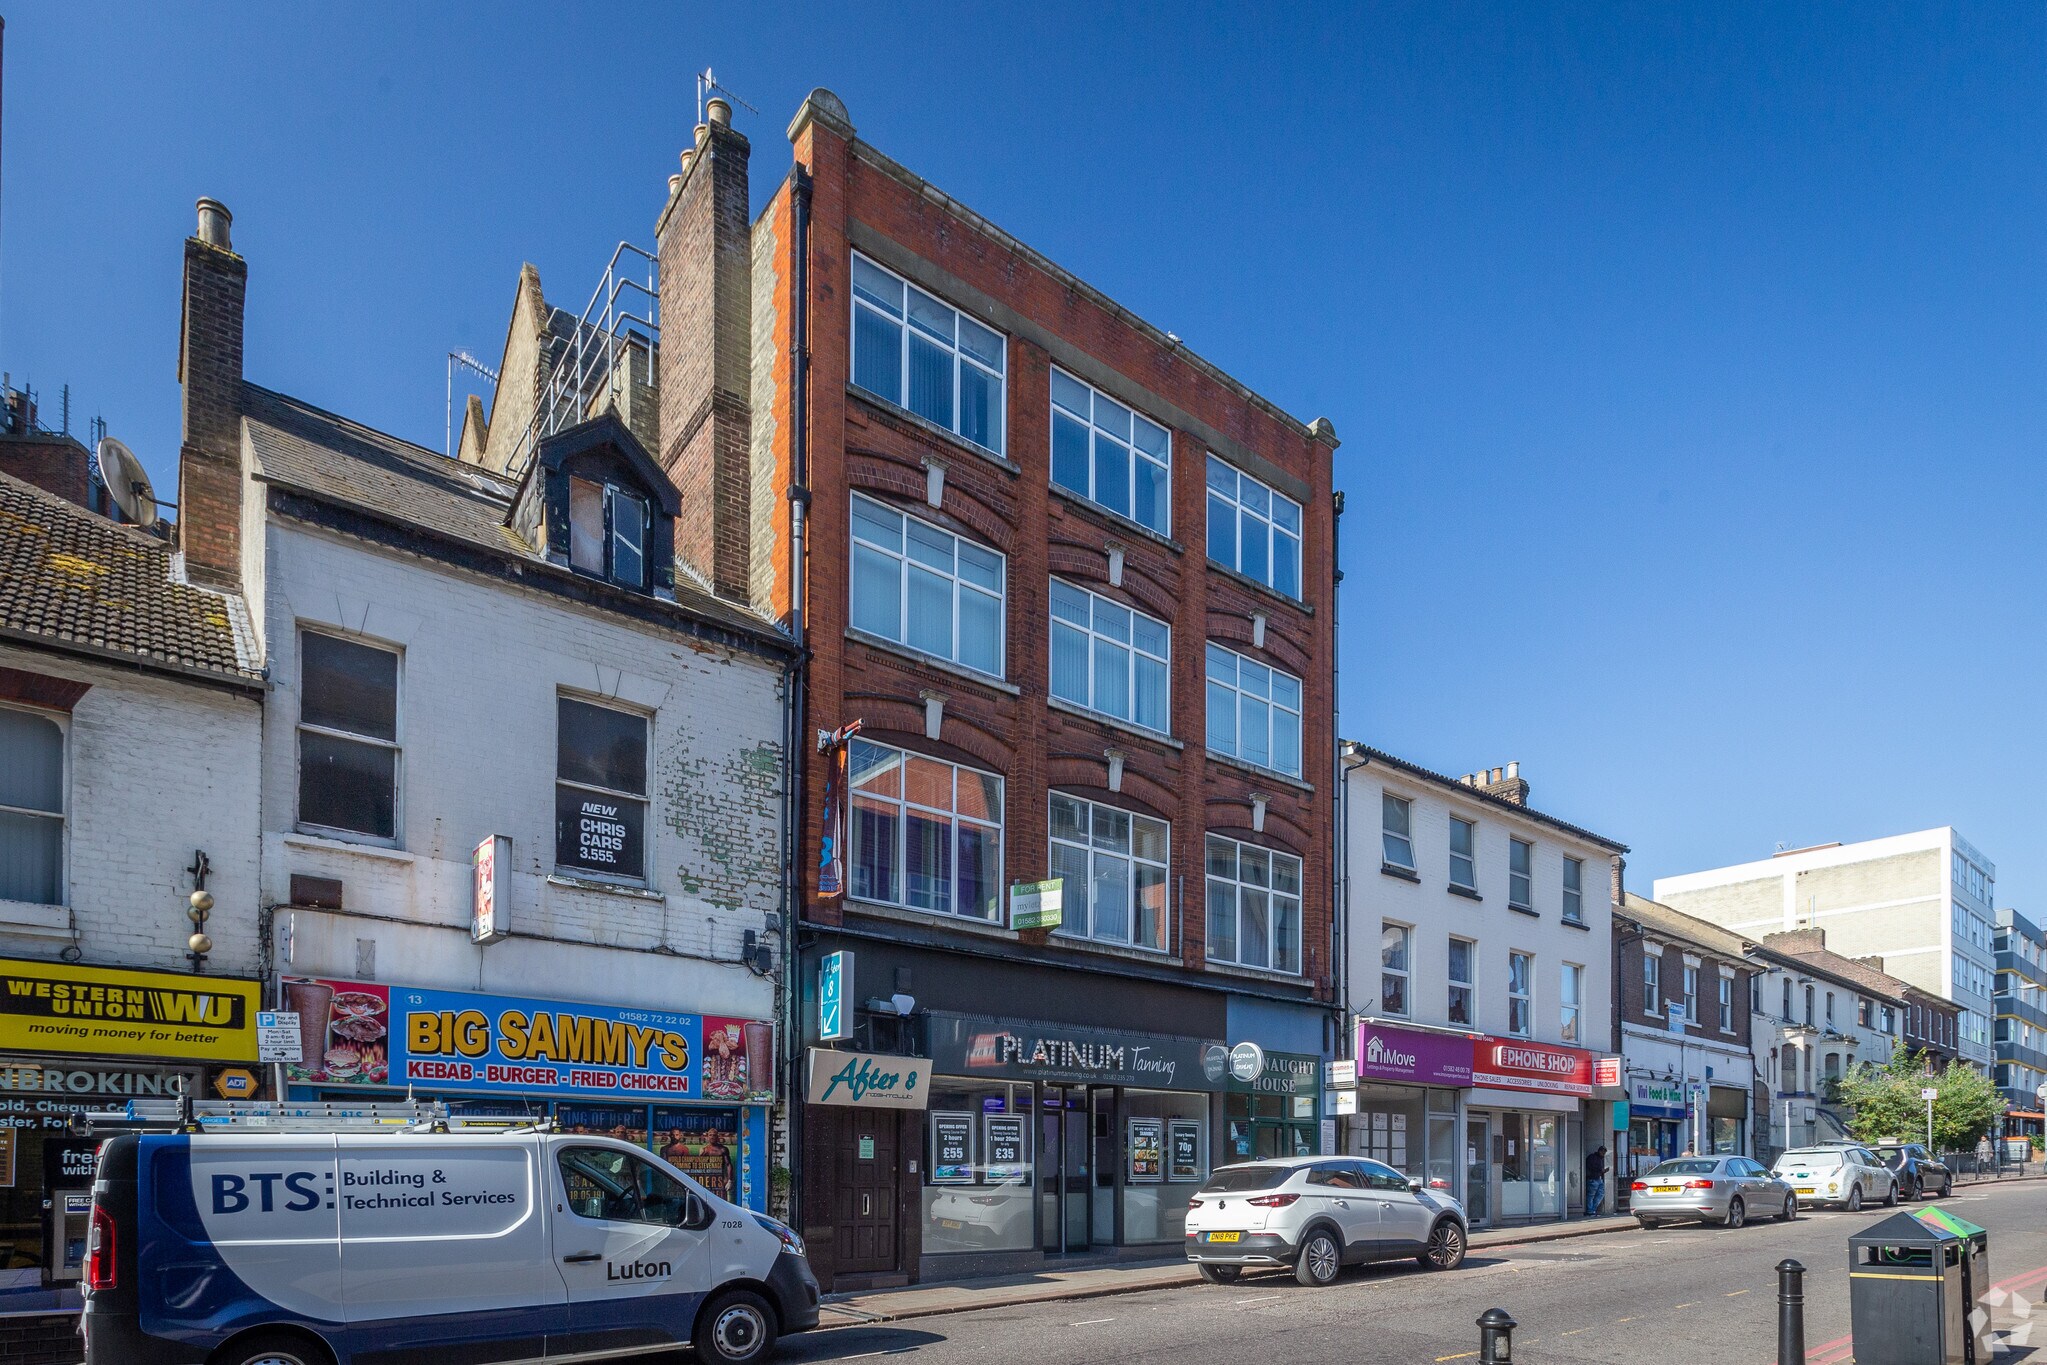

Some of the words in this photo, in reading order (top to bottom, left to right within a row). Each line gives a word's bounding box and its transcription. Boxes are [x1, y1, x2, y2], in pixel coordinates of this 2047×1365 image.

[582, 802, 617, 816] NEW
[580, 818, 626, 838] CHRIS
[580, 832, 623, 851] CARS
[580, 846, 617, 863] 3.555.
[1020, 884, 1035, 894] FOR
[1036, 882, 1056, 890] RENT
[1018, 917, 1036, 925] 01582
[826, 960, 841, 975] After
[7, 980, 145, 1004] WESTERN
[828, 980, 834, 997] 8
[408, 994, 422, 1005] 13
[52, 999, 145, 1019] UNION
[159, 992, 232, 1025] WU
[619, 1012, 648, 1022] 01582
[651, 1014, 664, 1023] 72
[666, 1016, 678, 1024] 22
[679, 1017, 692, 1026] 02
[28, 1022, 89, 1038] moving
[93, 1028, 146, 1041] money
[149, 1031, 171, 1041] for
[175, 1031, 219, 1044] better
[408, 1010, 489, 1057] BIG
[499, 1011, 689, 1070] SAMMY'S
[1003, 1036, 1124, 1071] PLATINUM
[1131, 1046, 1176, 1084] Tanning
[1384, 1048, 1416, 1066] iMove
[1508, 1050, 1546, 1070] PHONE
[1548, 1055, 1574, 1072] SHOP
[1232, 1059, 1254, 1074] Tanning
[226, 1076, 246, 1089] ADT
[408, 1062, 472, 1080] KEBAB
[487, 1067, 558, 1085] BURGER
[572, 1073, 616, 1088] FRIED
[620, 1074, 688, 1091] CHICKEN
[821, 1057, 899, 1102] After
[905, 1071, 917, 1090] 8
[1252, 1078, 1296, 1092] HOUSE
[1637, 1085, 1647, 1098] Vivi
[1649, 1086, 1662, 1100] Food
[1664, 1088, 1667, 1100] &
[1669, 1088, 1681, 1102] Wine
[592, 1112, 606, 1126] OF
[687, 1116, 698, 1129] OF
[943, 1148, 963, 1159] £55
[996, 1148, 1014, 1159] £35
[1179, 1142, 1192, 1153] 70p
[344, 1170, 424, 1188] Building
[432, 1170, 446, 1184] &
[211, 1172, 320, 1214] BTS
[344, 1192, 434, 1210] Technical
[442, 1192, 516, 1206] Services
[1225, 1232, 1236, 1240] PKE
[607, 1260, 672, 1280] Luton
